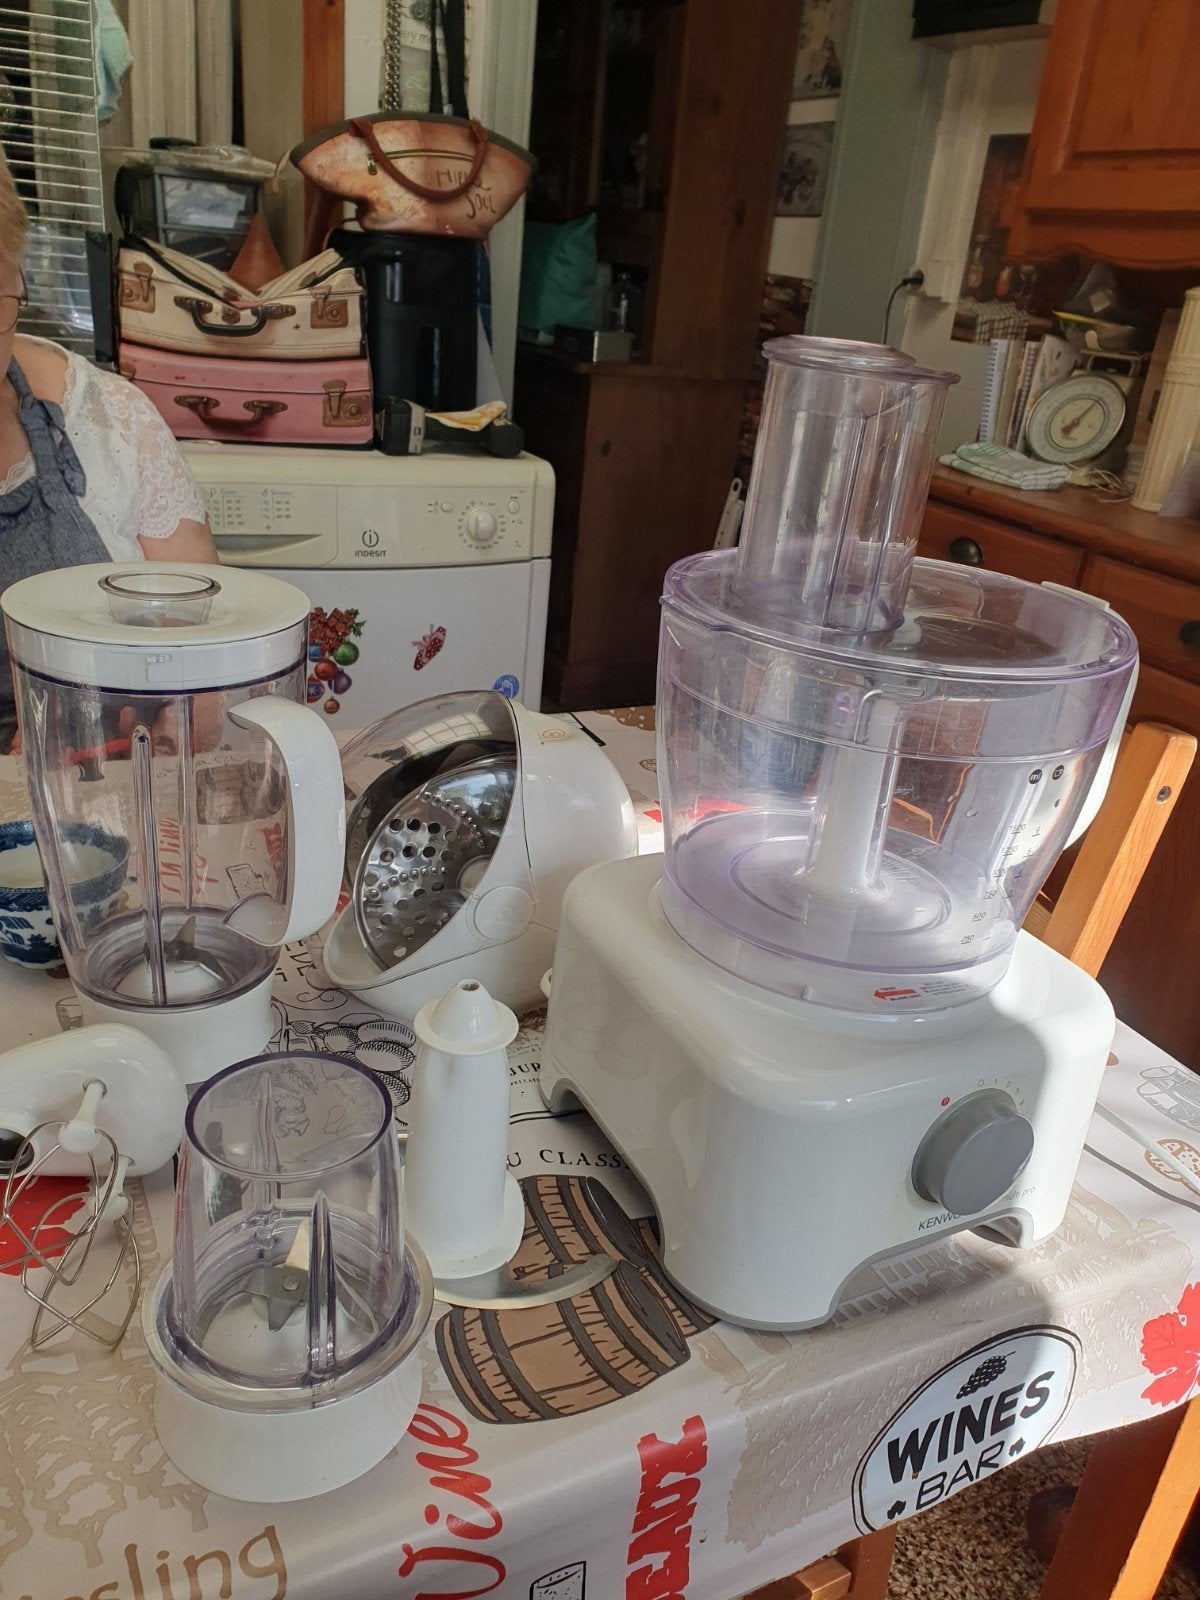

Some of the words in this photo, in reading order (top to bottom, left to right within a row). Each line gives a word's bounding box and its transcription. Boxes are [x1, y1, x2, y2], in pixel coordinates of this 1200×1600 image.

[1021, 1186, 1036, 1199] pro
[888, 1370, 1055, 1484] WINES
[916, 1440, 1005, 1511] BAR
